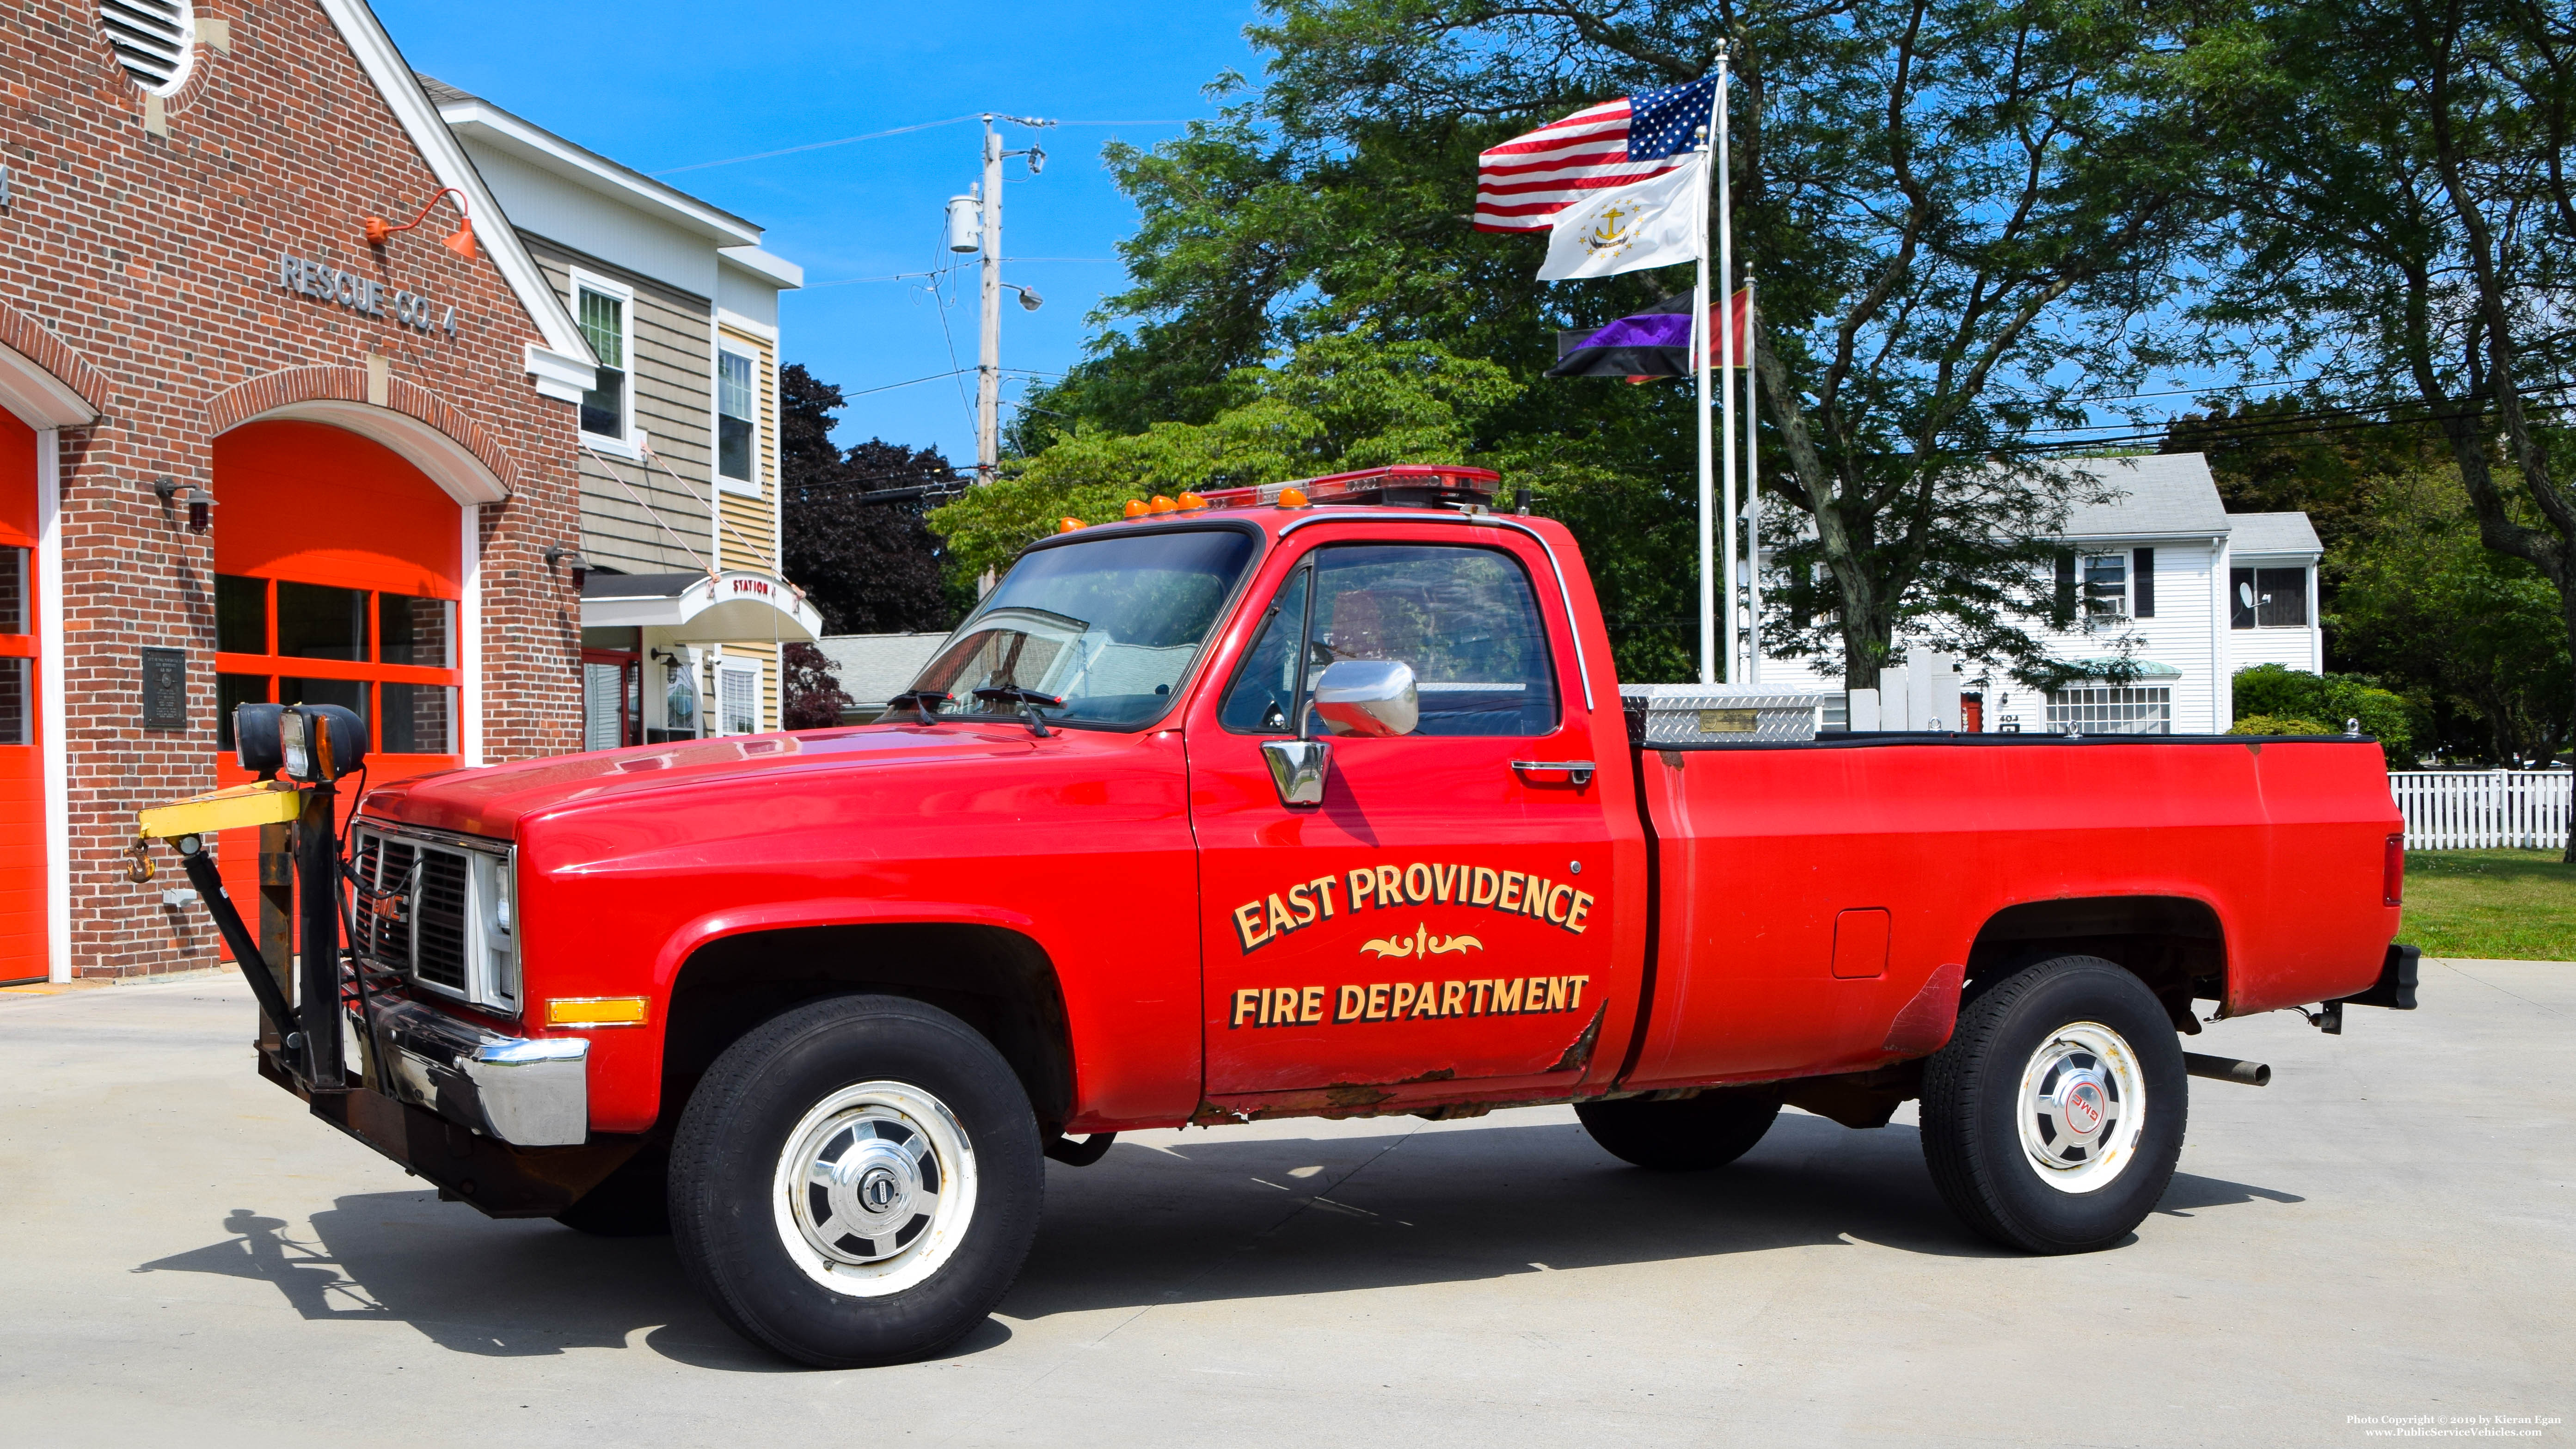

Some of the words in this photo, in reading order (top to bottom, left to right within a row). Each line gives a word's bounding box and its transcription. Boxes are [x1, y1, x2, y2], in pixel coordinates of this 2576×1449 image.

[281, 253, 385, 316] RESCUE
[395, 290, 435, 331] CO.
[443, 306, 457, 337] 4
[733, 580, 768, 595] STATION
[1232, 875, 1337, 955] EAST
[1345, 863, 1594, 934] PROVIDENCE
[1229, 986, 1325, 1029] FIRE
[1332, 975, 1589, 1025] DEPARTMENT
[2072, 1094, 2098, 1121] GMC
